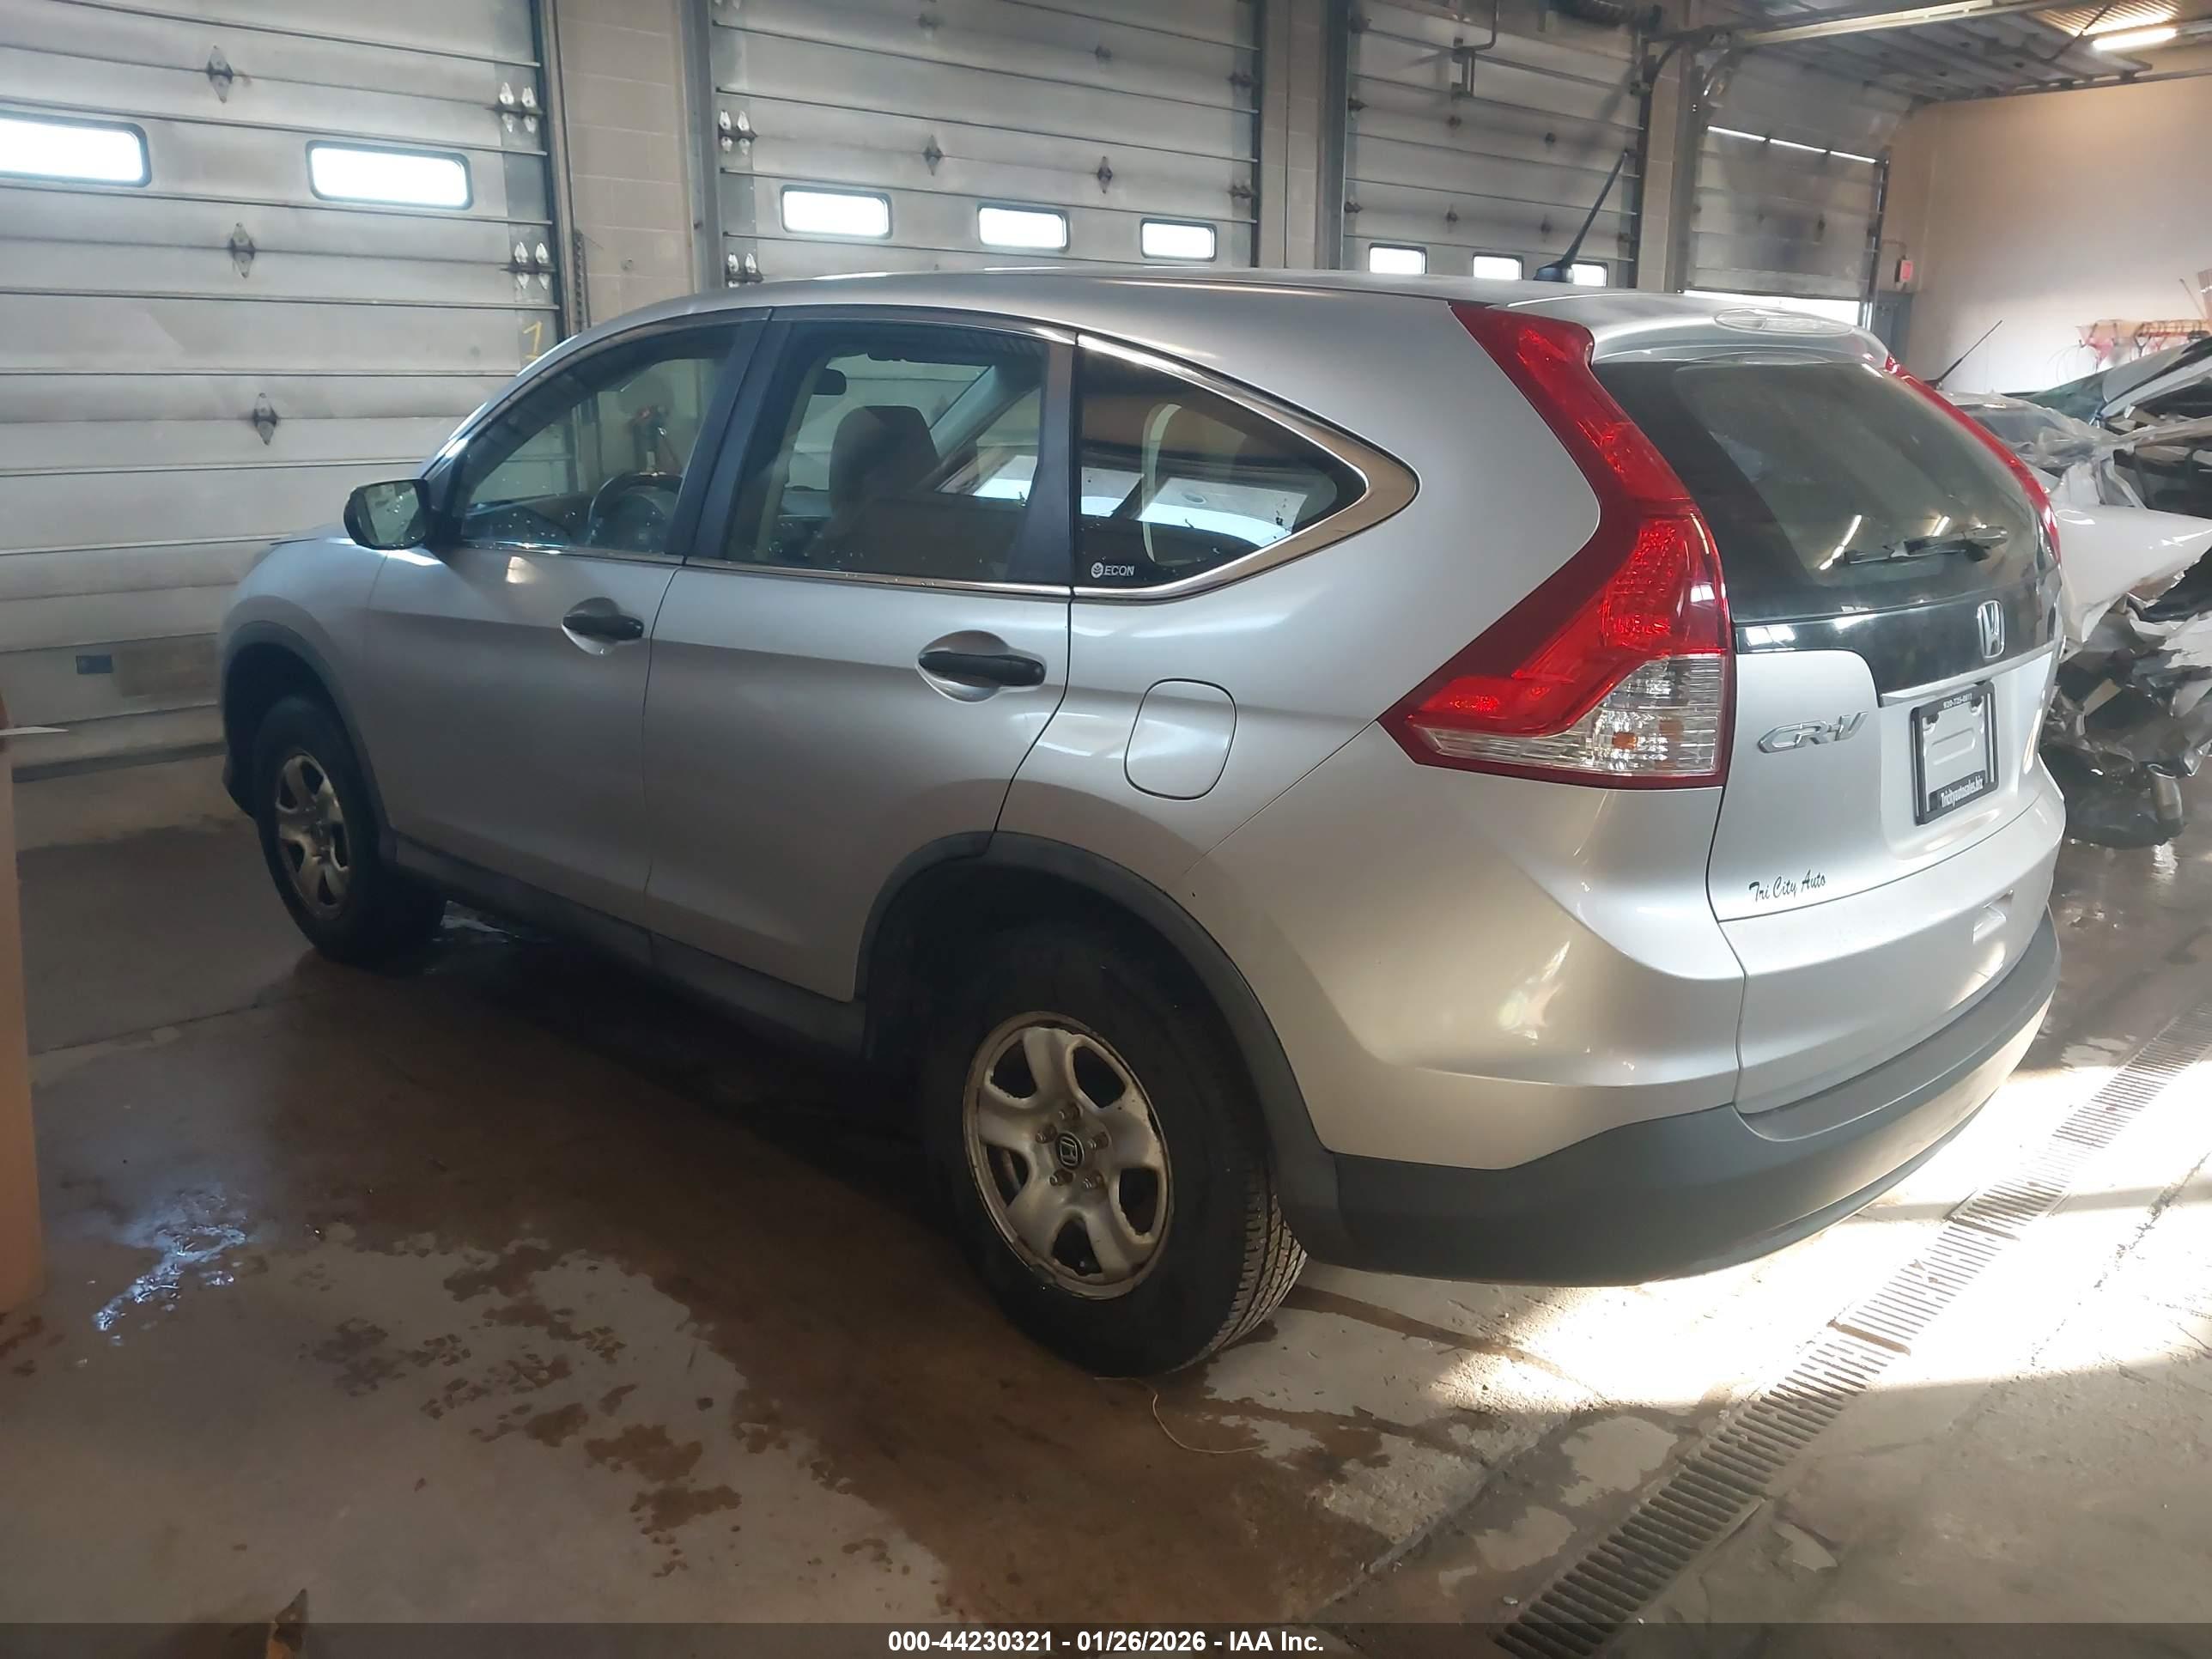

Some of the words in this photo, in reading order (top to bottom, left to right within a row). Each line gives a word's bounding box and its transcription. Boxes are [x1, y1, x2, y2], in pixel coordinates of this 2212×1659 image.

[1103, 564, 1135, 577] ECON
[1757, 711, 1869, 754] CR-V
[1748, 880, 1770, 902] Tri
[1772, 875, 1797, 899] City
[1801, 868, 1826, 892] Auto
